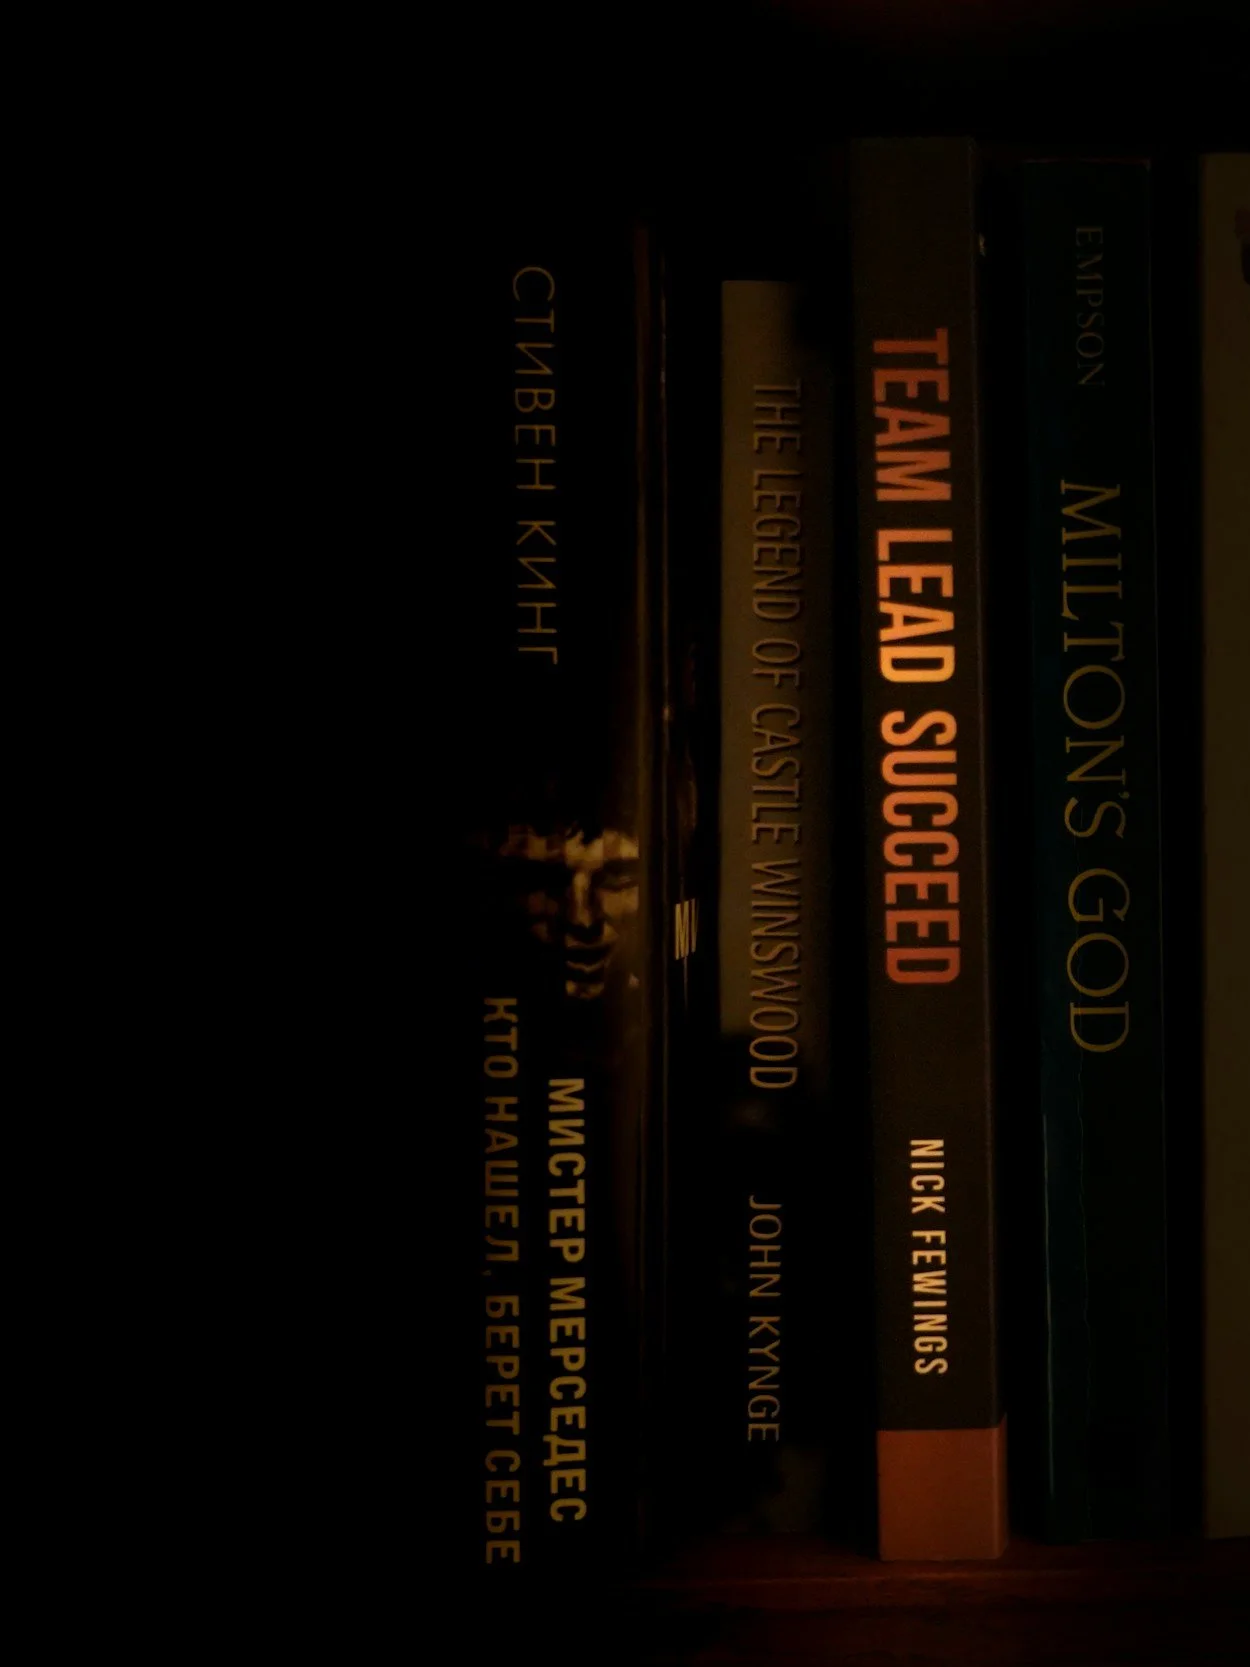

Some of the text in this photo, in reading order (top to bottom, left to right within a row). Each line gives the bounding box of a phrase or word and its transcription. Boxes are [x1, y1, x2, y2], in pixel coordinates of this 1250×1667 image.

[511, 264, 558, 666] СТИВЕН КИНГ
[1073, 225, 1106, 389] EMPSON
[746, 378, 802, 1091] THE LEGEND OF CASTLE WINSWOOD
[871, 326, 962, 987] TEAM LEAD SUCCEED
[1059, 479, 1132, 1054] MILTON'S GOD
[478, 995, 521, 1566] КТО НАШЕЛ, БЕРЕТ СЕБЕ
[543, 1077, 588, 1523] МИСТЕР МЕРСЕДЕС
[745, 1194, 782, 1442] JOHN KYNGE
[909, 1137, 947, 1376] NICK FEWINGS
